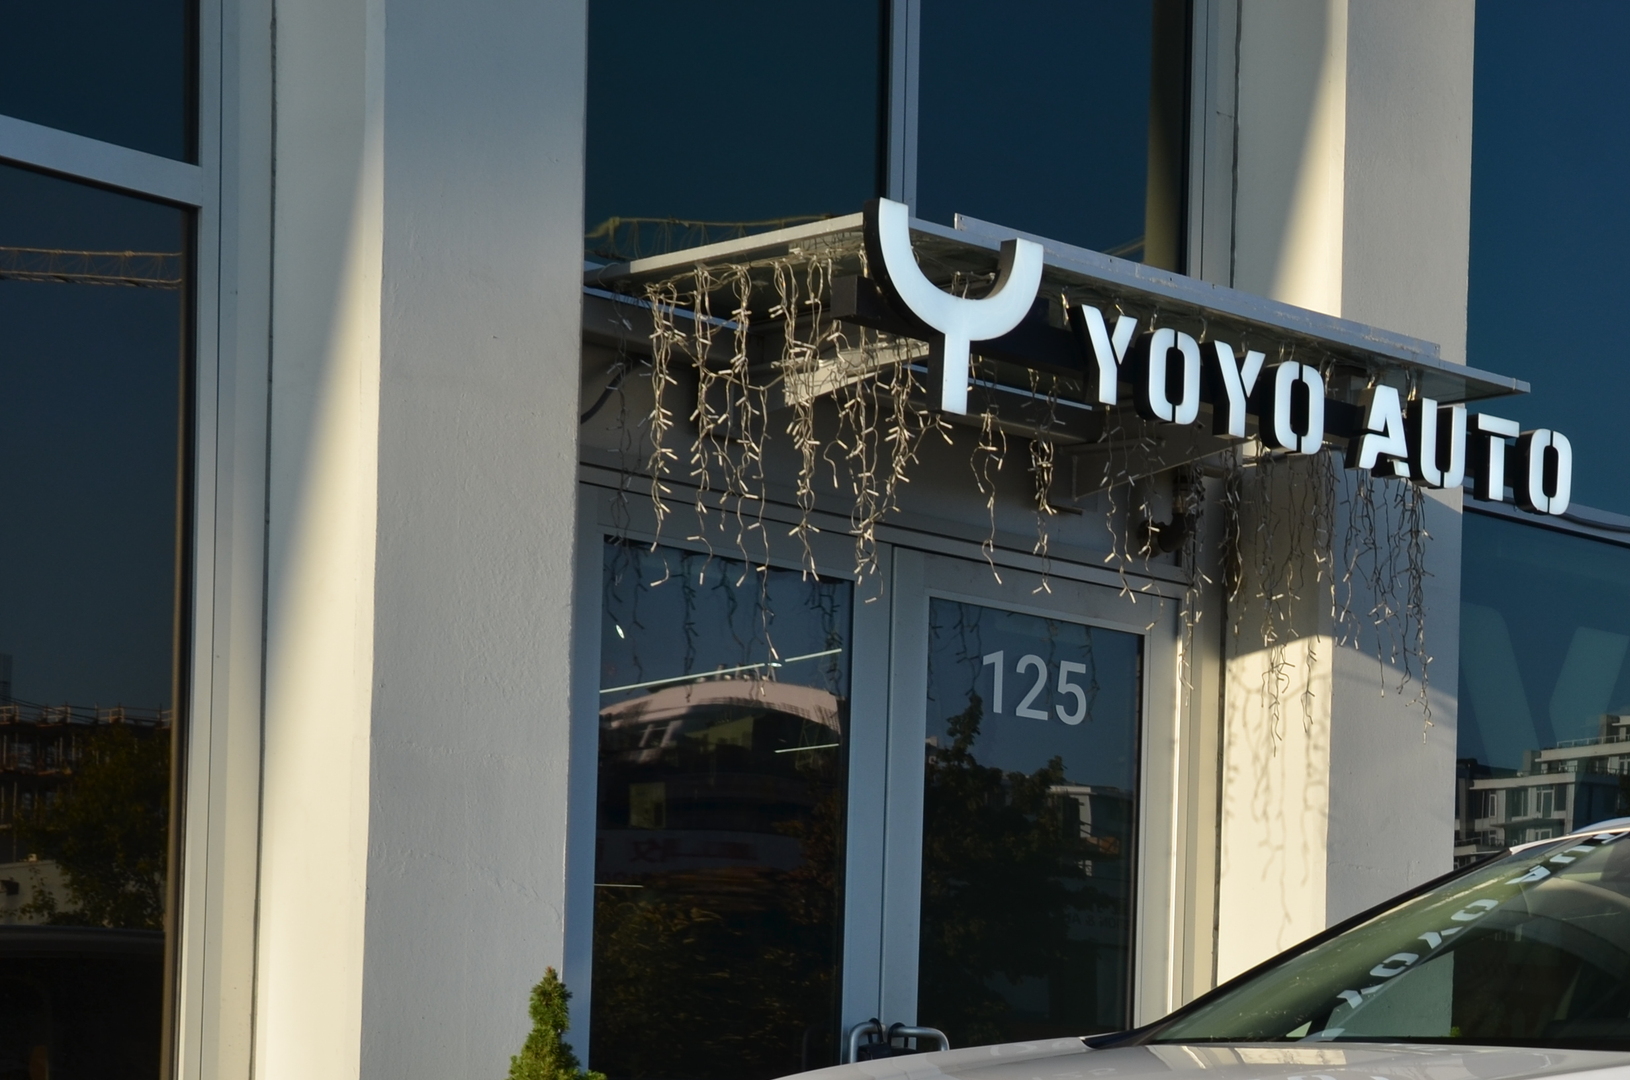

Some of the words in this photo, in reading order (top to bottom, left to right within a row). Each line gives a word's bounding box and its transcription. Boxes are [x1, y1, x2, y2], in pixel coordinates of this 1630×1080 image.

[1081, 304, 1325, 455] YOYO
[1356, 383, 1574, 516] AUTO
[983, 650, 1087, 725] 125
